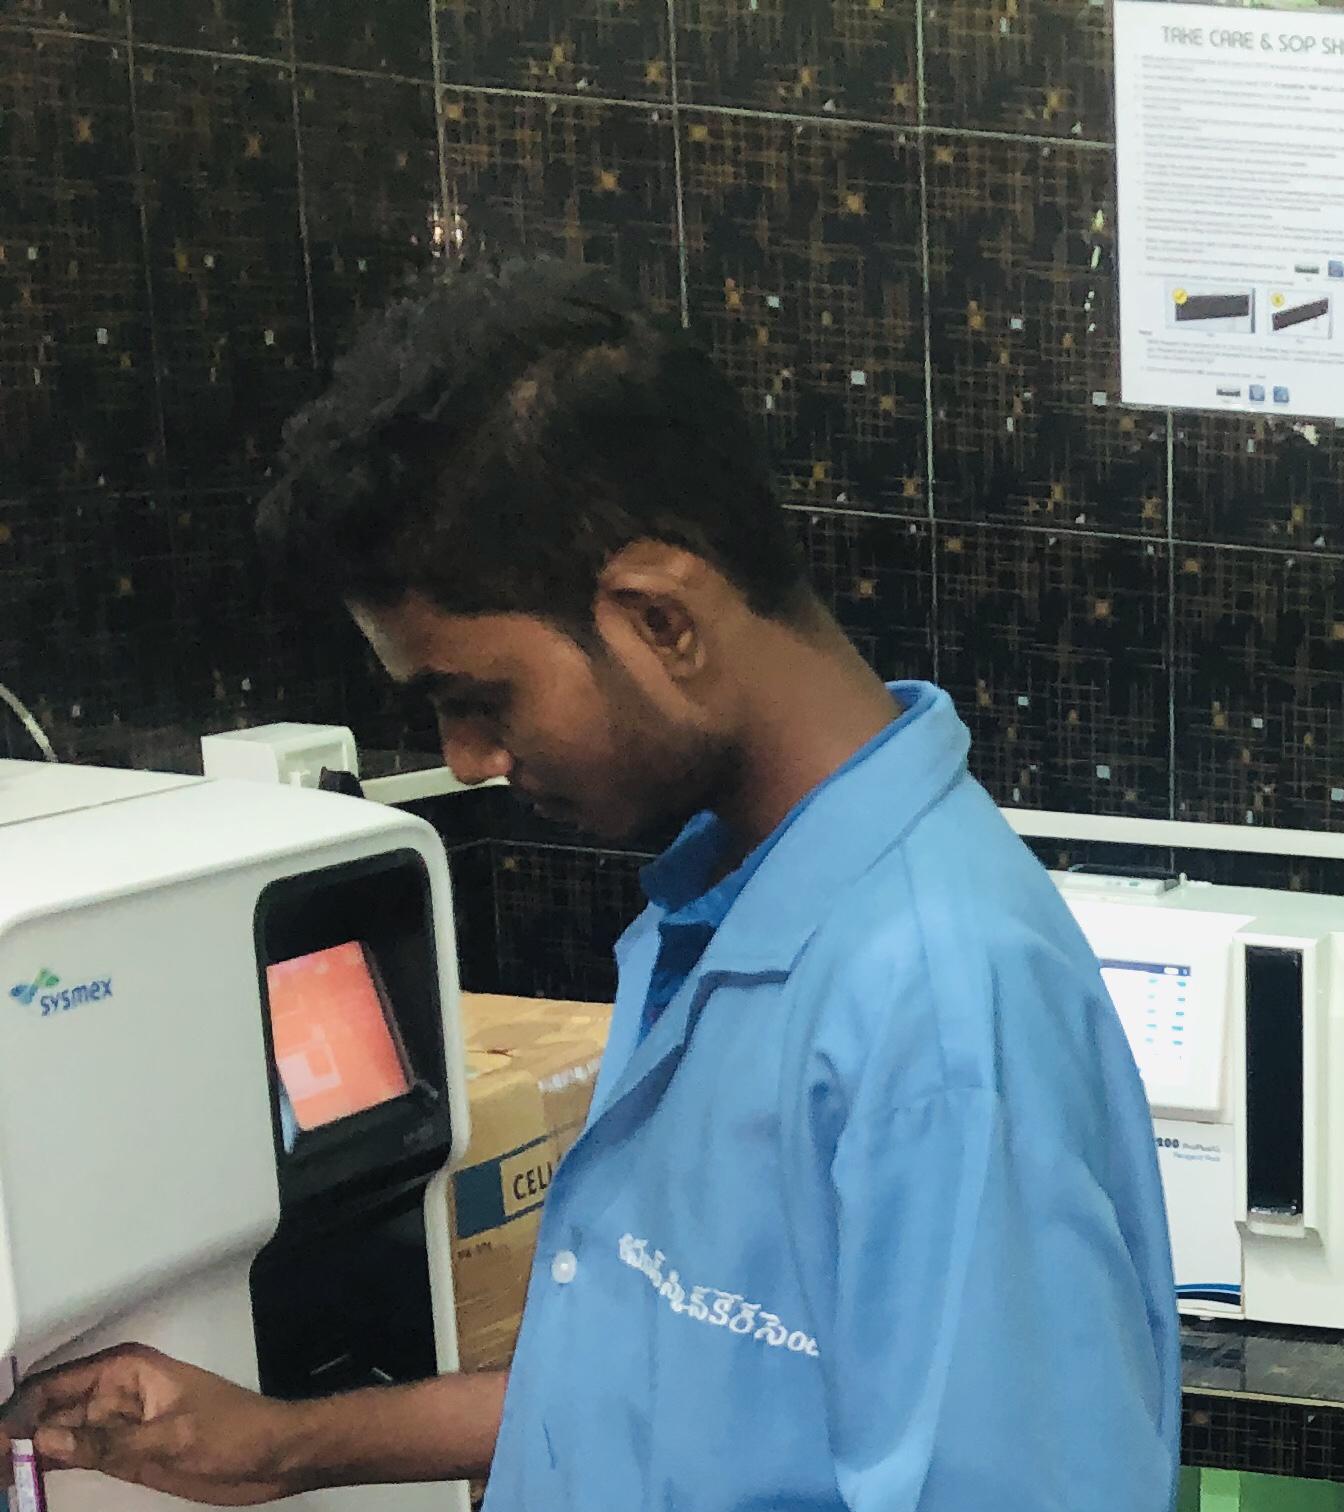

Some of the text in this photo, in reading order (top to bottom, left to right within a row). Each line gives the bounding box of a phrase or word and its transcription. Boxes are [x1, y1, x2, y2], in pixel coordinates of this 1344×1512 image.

[1161, 25, 1203, 46] TAKE
[1209, 29, 1254, 50] CARE
[1259, 32, 1274, 51] &
[1278, 33, 1316, 53] SOP
